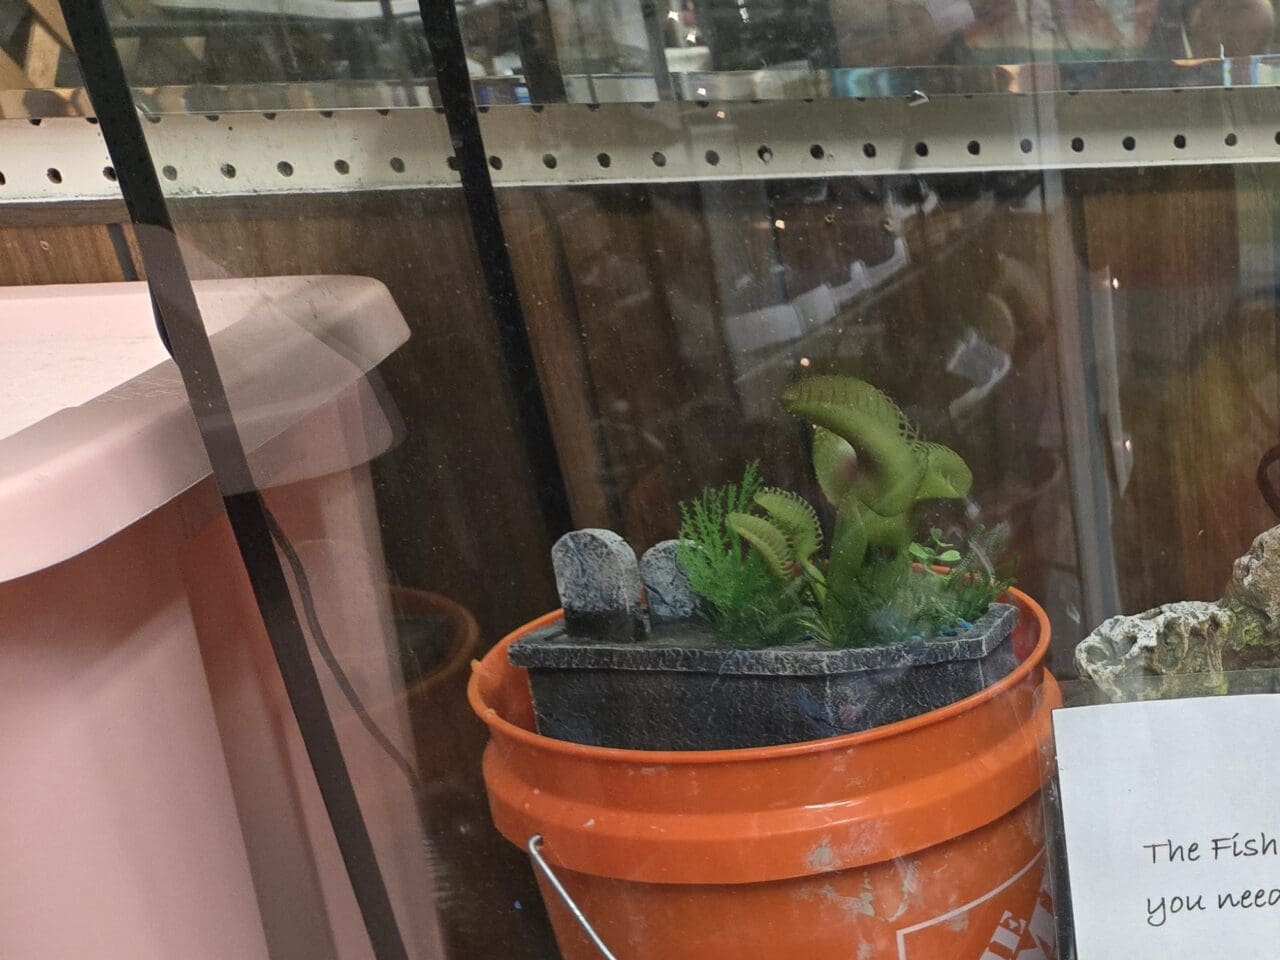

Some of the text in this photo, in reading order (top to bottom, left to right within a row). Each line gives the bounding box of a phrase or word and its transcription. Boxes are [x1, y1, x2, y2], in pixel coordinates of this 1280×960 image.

[1143, 838, 1201, 864] The
[1211, 832, 1278, 861] Fish
[1146, 892, 1207, 927] you
